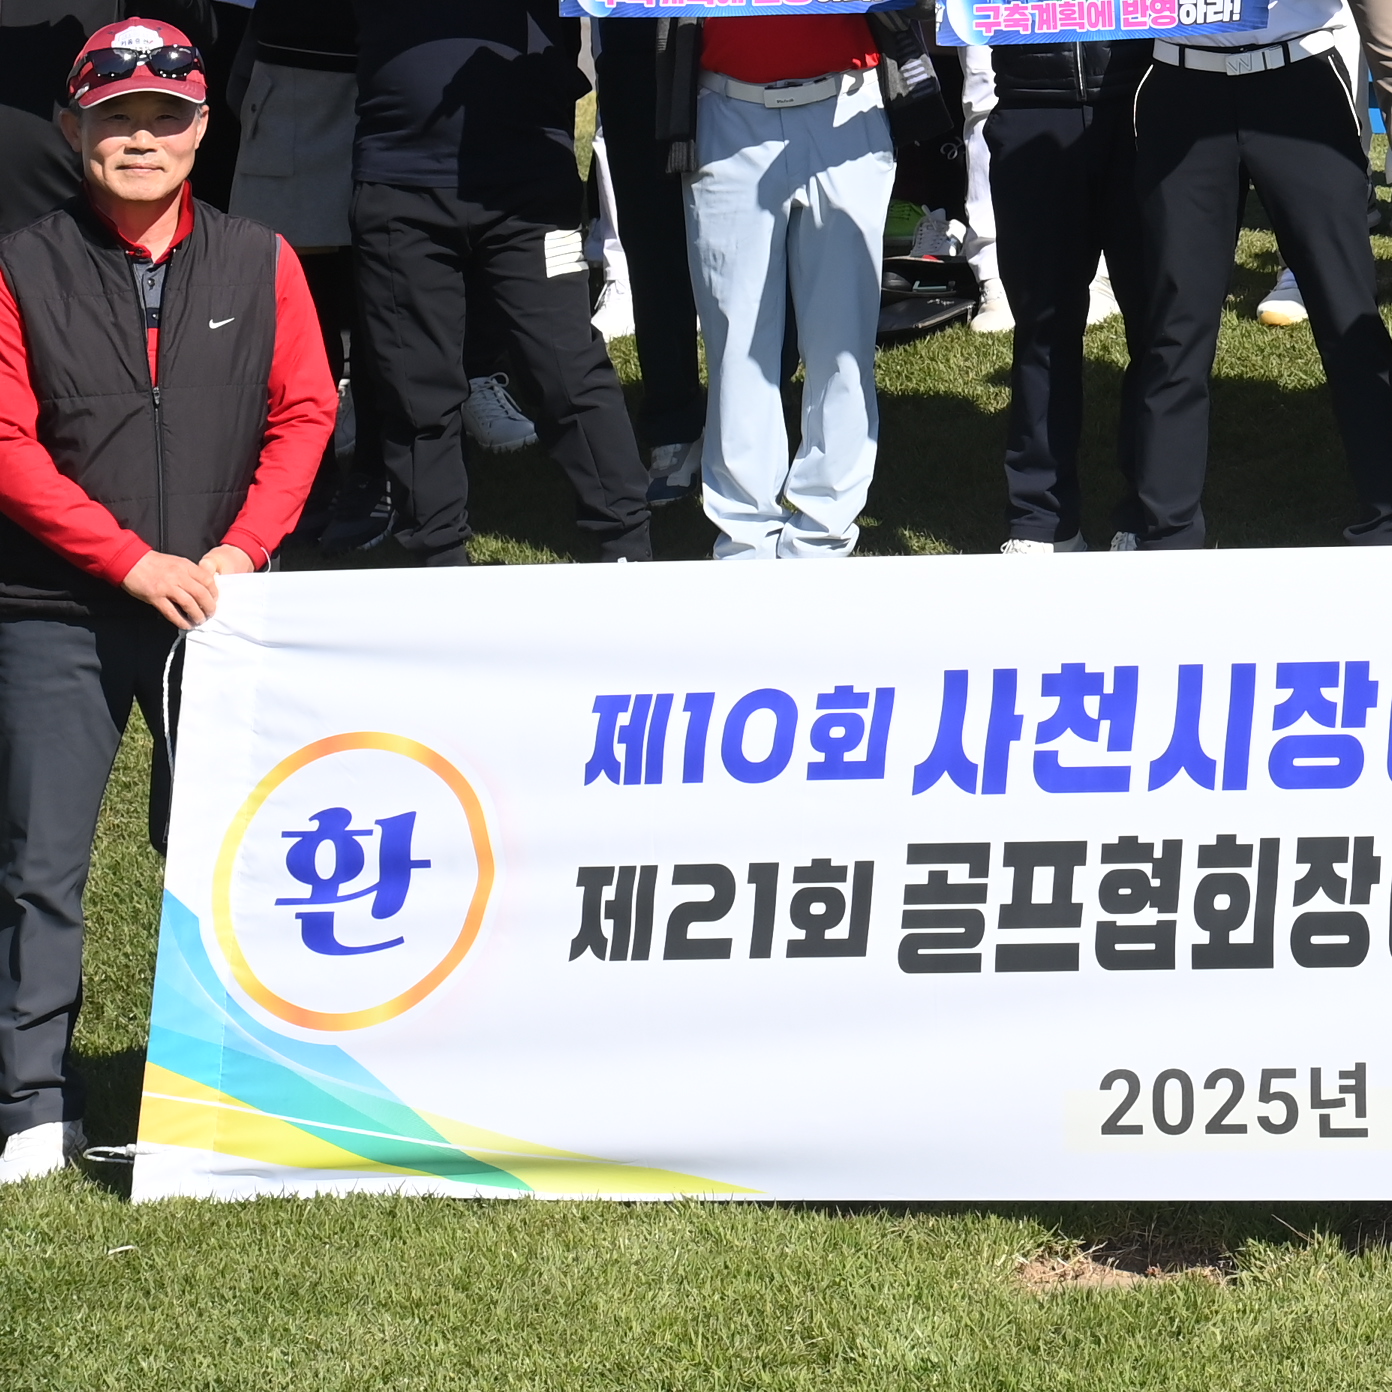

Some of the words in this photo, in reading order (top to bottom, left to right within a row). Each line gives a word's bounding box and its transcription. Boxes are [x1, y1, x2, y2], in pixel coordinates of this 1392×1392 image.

[974, 0, 1114, 36] 구축계획에
[583, 683, 897, 787] 제10회
[275, 806, 431, 957] 환
[569, 858, 876, 963] 제21회
[1099, 1061, 1370, 1140] 2025년
